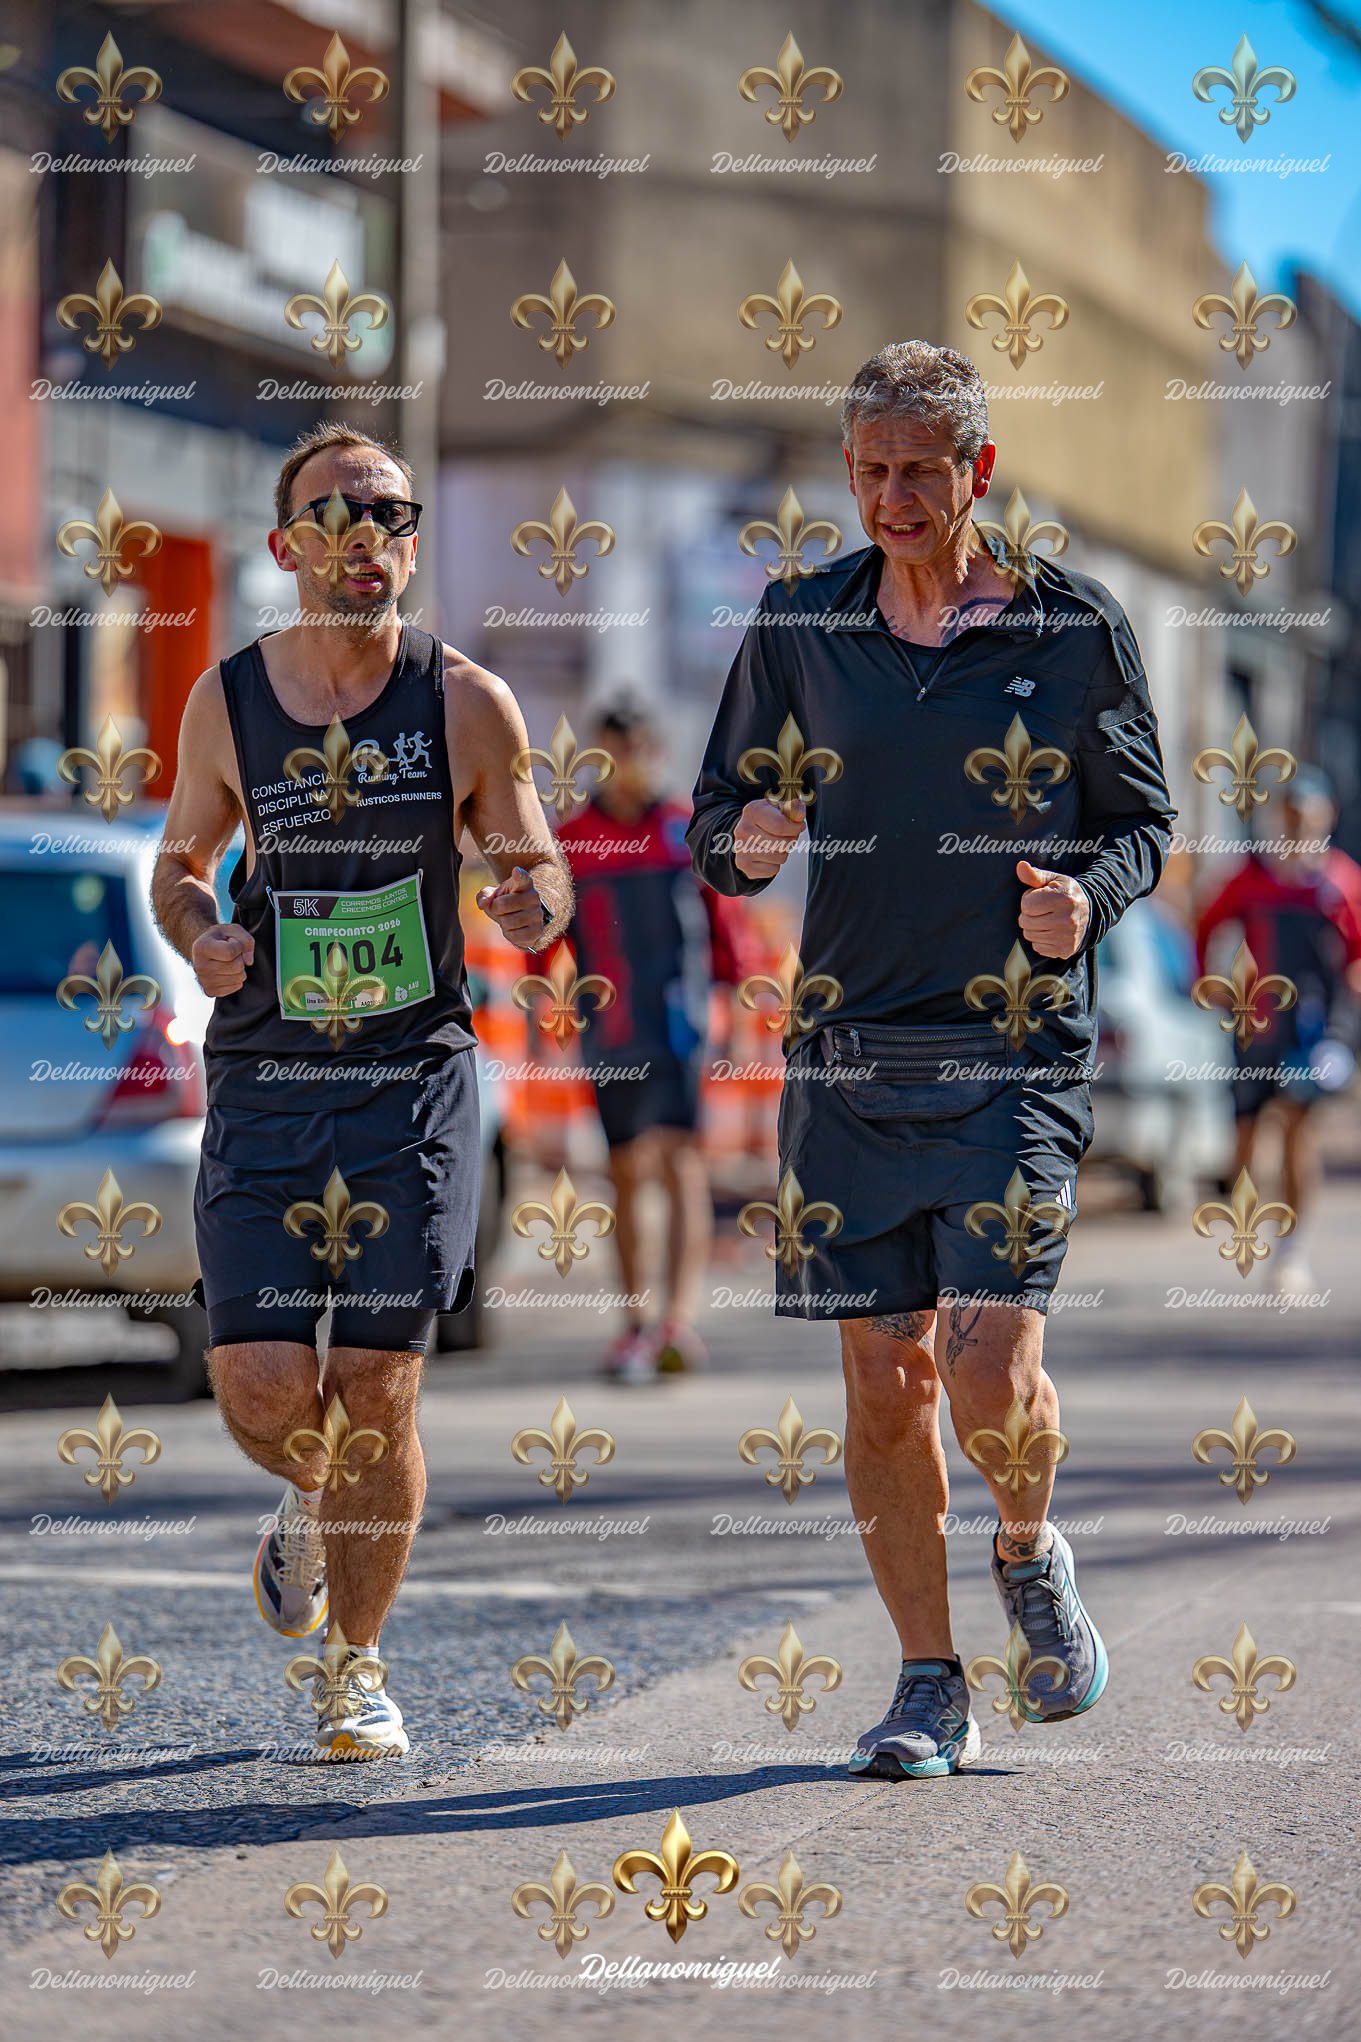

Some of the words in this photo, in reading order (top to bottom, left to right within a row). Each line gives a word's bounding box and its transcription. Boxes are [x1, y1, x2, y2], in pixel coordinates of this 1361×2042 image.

[251, 771, 335, 800] CONSTANCIA
[357, 772, 400, 786] Running
[400, 767, 427, 779] Team
[257, 788, 329, 817] DISCIPLINA
[356, 793, 400, 808] RUSTICOS
[401, 791, 442, 802] RUNNERS
[262, 808, 332, 836] ESFUERZO
[293, 898, 320, 917] 5K
[340, 897, 382, 907] CORREMOS
[341, 904, 382, 913] CRECEMOS
[304, 924, 375, 937] CAMPEONATO
[377, 918, 401, 931] 2026
[309, 933, 403, 978] 1004
